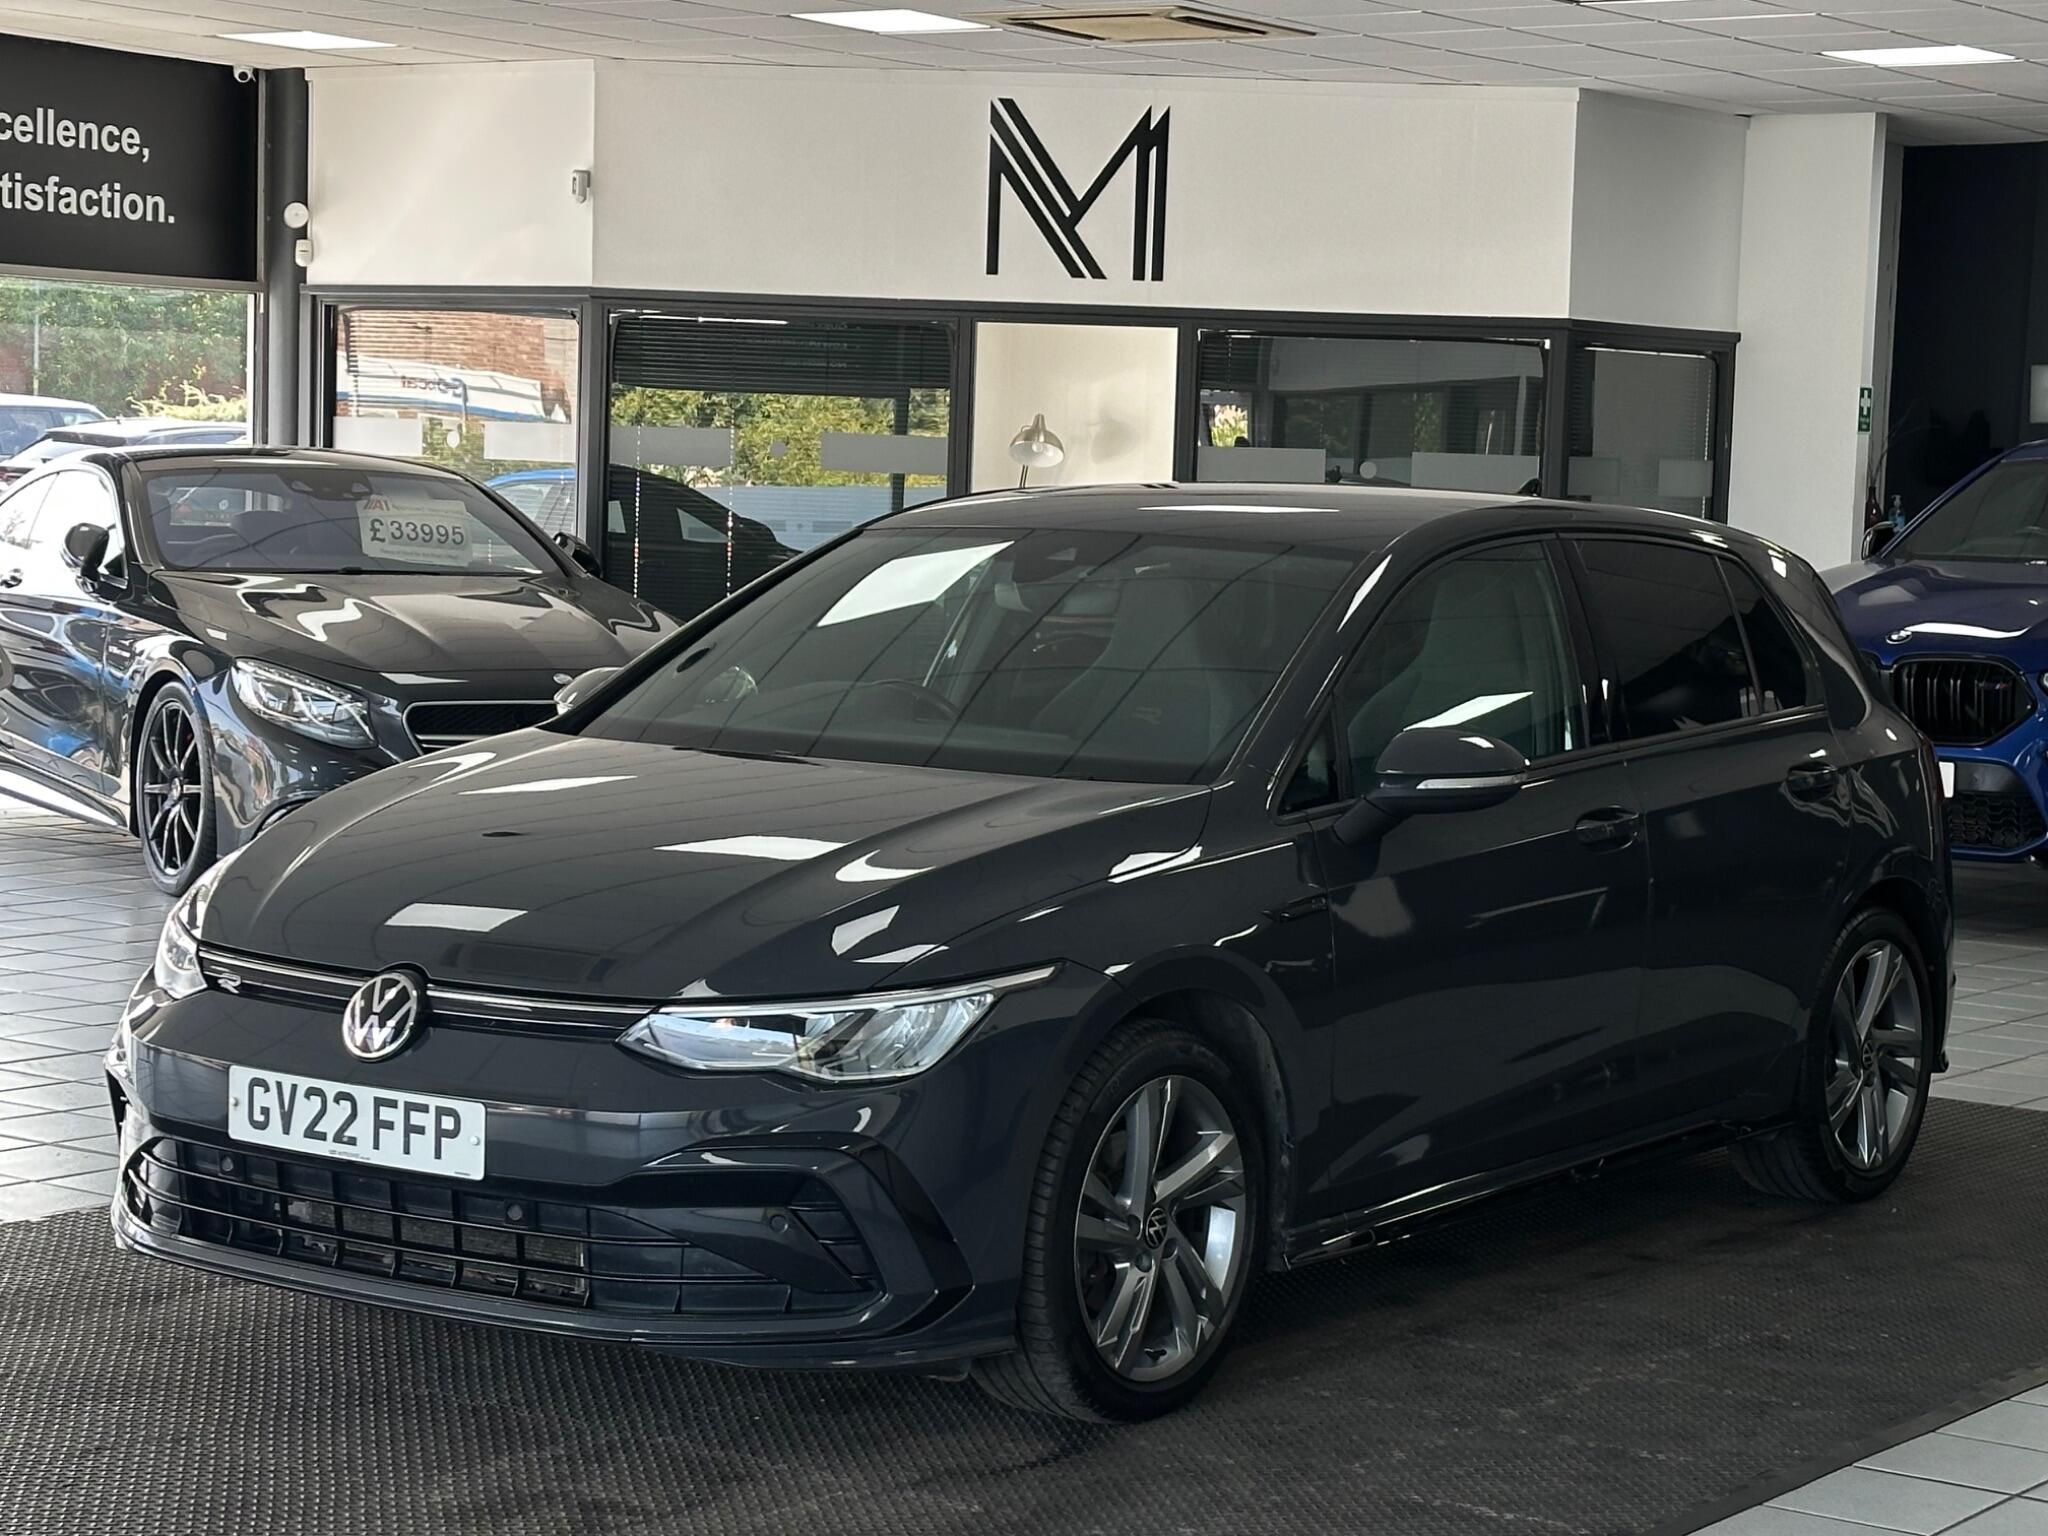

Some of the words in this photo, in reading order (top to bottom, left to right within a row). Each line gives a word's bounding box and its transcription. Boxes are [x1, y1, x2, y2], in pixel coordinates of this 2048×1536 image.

[0, 107, 151, 163] cellence,
[0, 172, 176, 224] tisfaction.
[369, 518, 465, 546] £33995
[247, 1076, 359, 1147] GV22
[372, 1095, 462, 1161] FFP
